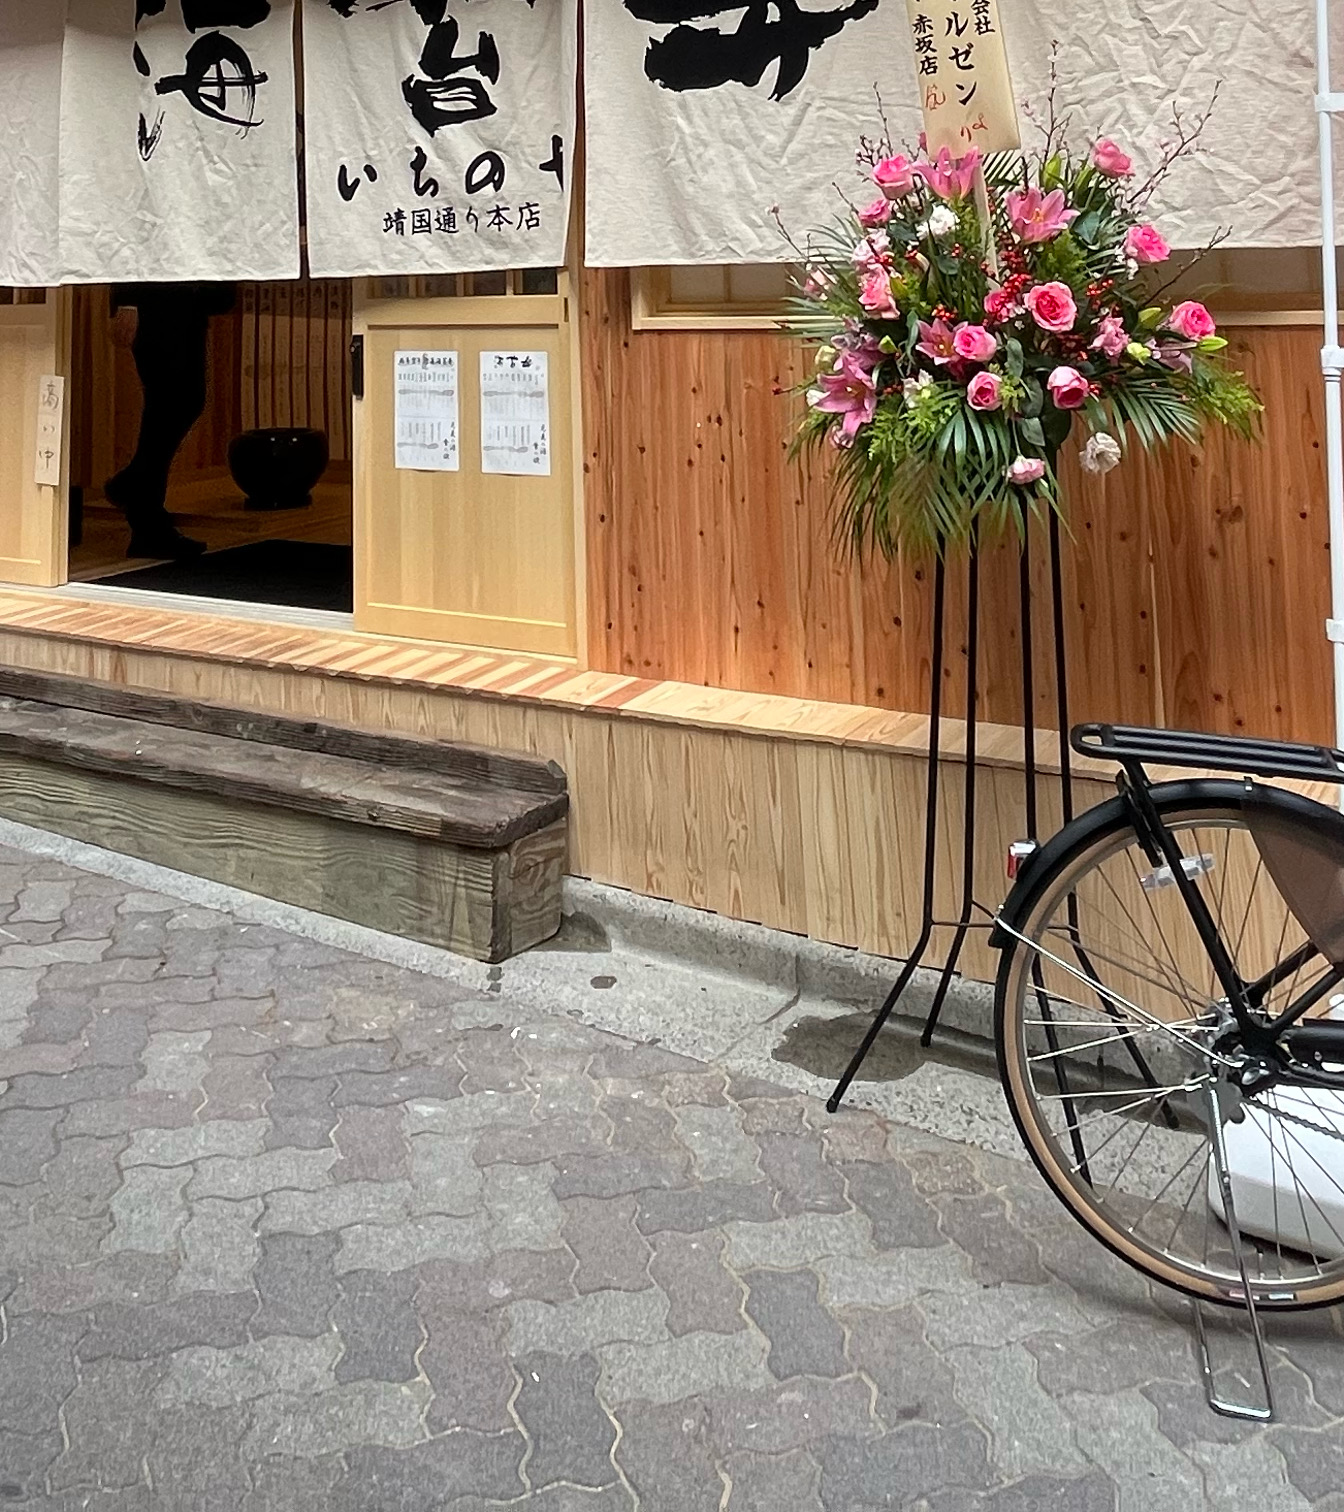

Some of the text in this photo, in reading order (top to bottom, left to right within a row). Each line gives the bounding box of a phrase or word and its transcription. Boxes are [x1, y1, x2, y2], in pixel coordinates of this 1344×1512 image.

[912, 14, 939, 76] 赤坂店
[383, 201, 541, 236] 靖国通り本店
